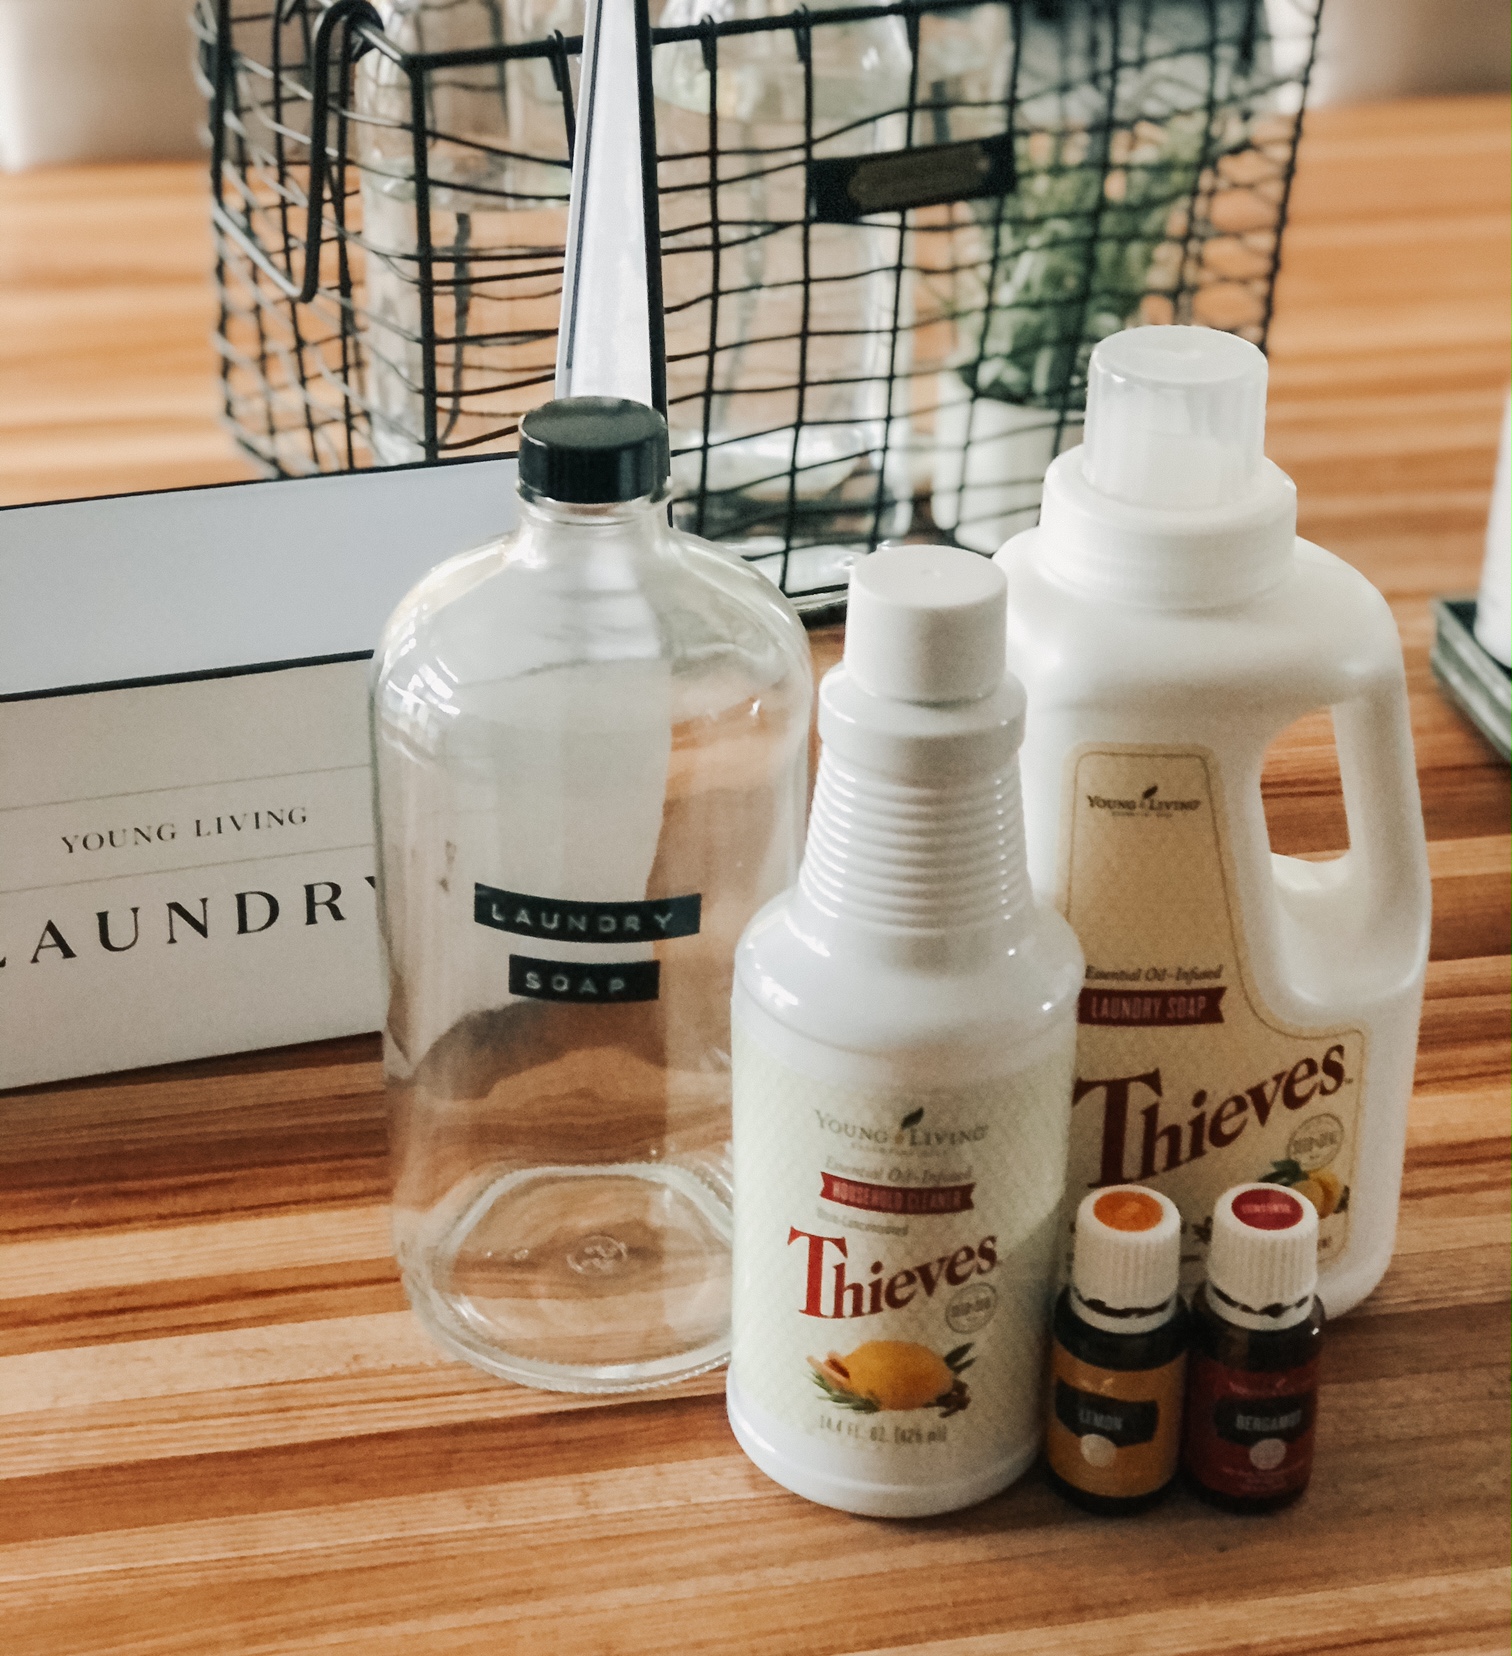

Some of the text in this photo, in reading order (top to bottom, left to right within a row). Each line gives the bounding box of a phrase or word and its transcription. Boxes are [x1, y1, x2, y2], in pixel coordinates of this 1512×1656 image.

[61, 806, 308, 854] YOUNG LIVING
[491, 903, 673, 933] LAUNDRY
[525, 971, 626, 995] SOAP
[1090, 995, 1207, 1020] LAUNDRY SOAP
[814, 1108, 989, 1147] YOUNG LIVING
[1071, 1044, 1346, 1188] Thieves
[787, 1225, 998, 1319] Thieves
